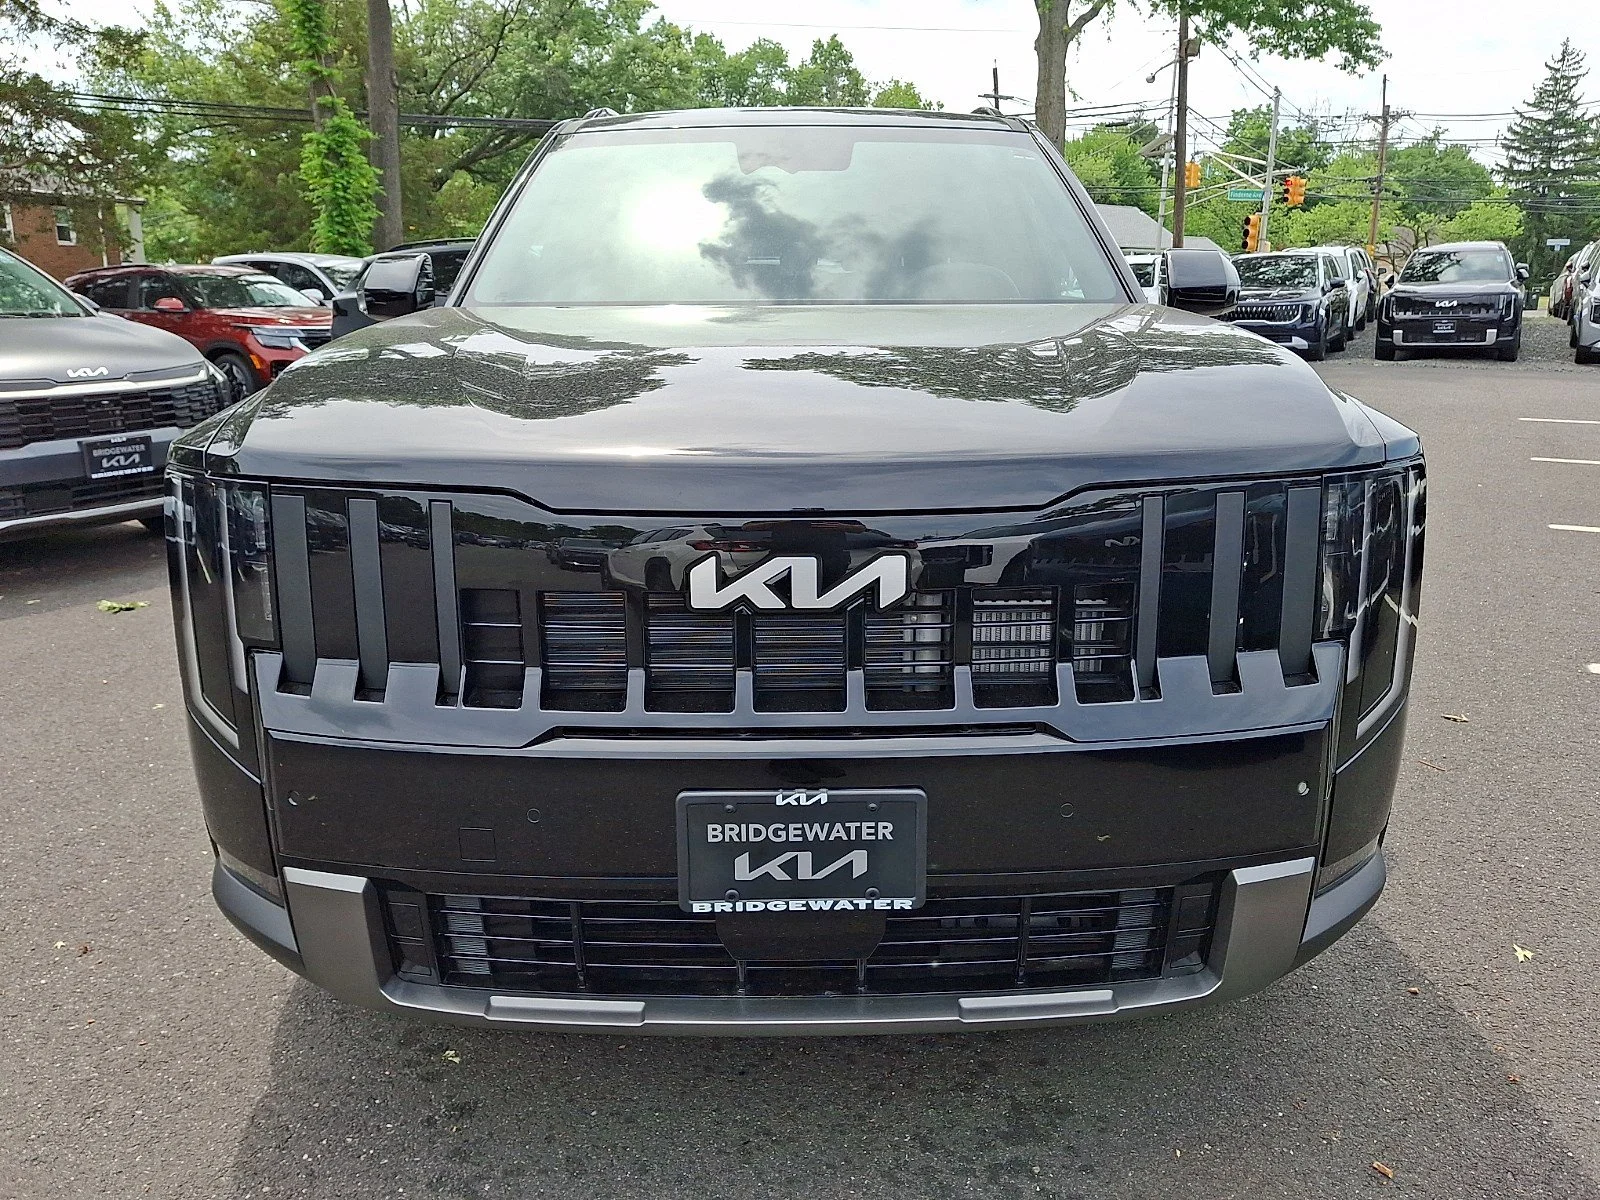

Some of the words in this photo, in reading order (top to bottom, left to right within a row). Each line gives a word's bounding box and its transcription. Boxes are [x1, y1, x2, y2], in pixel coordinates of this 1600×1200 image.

[67, 366, 109, 378] KIA
[92, 444, 146, 457] BRIDGEWATER
[102, 453, 140, 468] KIA
[690, 555, 907, 609] KIA
[775, 790, 829, 806] KIA
[706, 822, 894, 843] BRIDGEWATER
[734, 850, 868, 881] KIA
[692, 899, 913, 913] BRIDGEWATER
